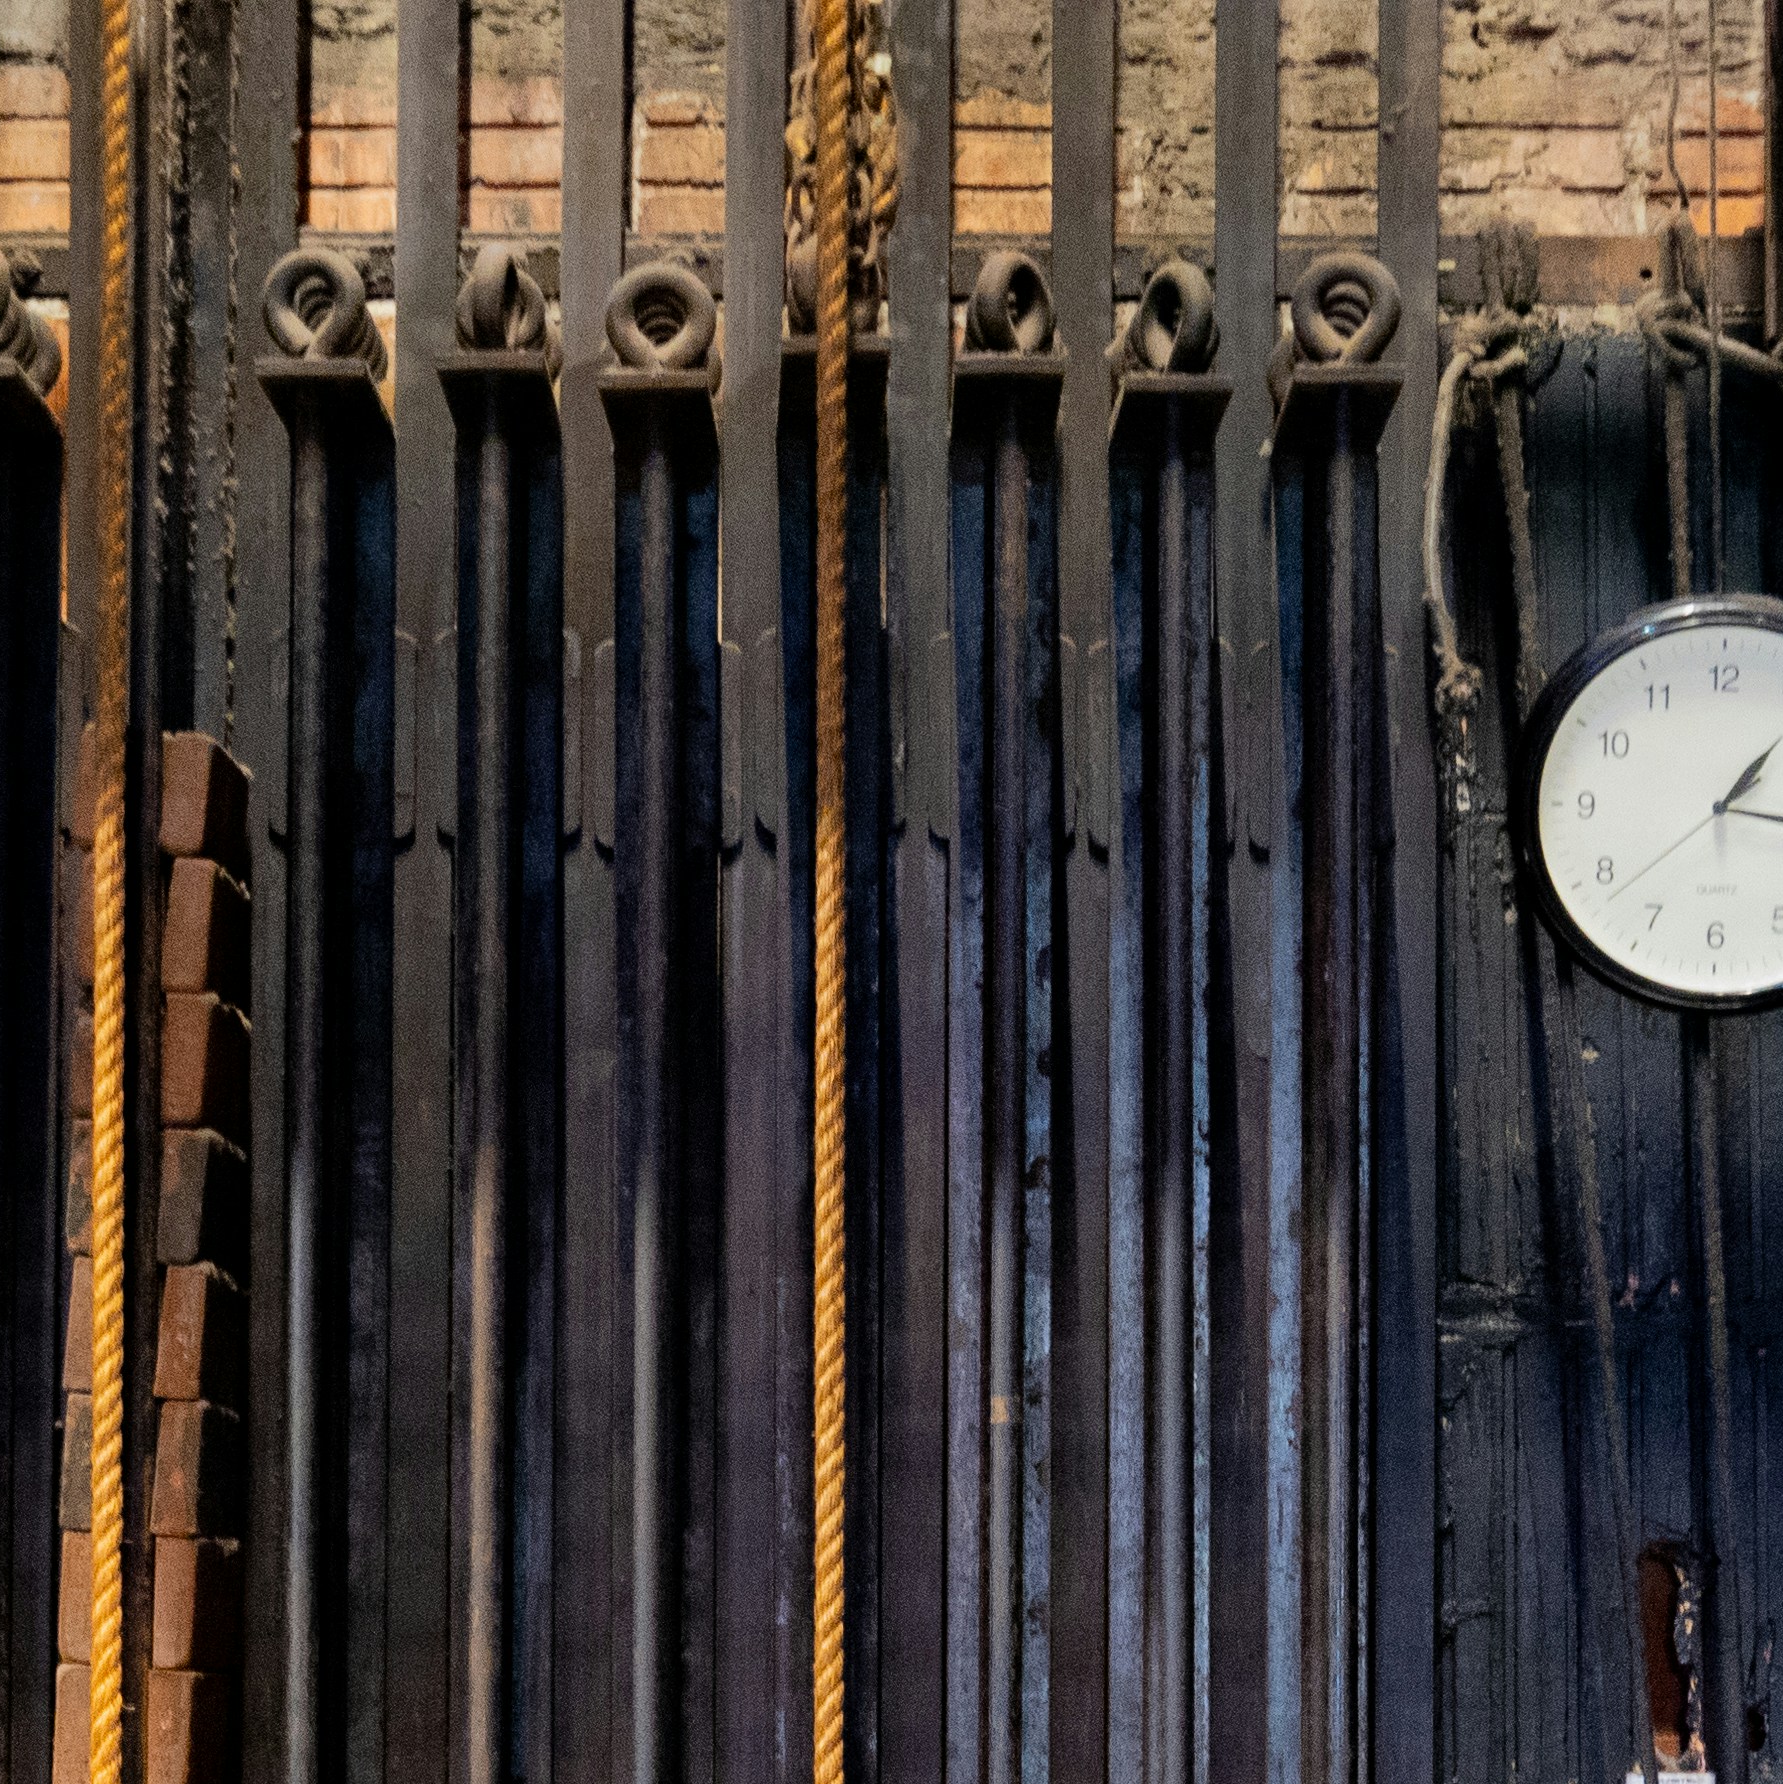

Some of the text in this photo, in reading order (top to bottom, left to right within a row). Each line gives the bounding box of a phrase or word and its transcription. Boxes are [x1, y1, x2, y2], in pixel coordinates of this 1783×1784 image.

[1709, 665, 1740, 694] 12
[1644, 684, 1671, 710] 11
[1598, 731, 1630, 759] 10
[1577, 791, 1595, 819] 9
[1596, 856, 1614, 884] 8
[1645, 904, 1663, 931] 7
[1706, 922, 1725, 949] 6
